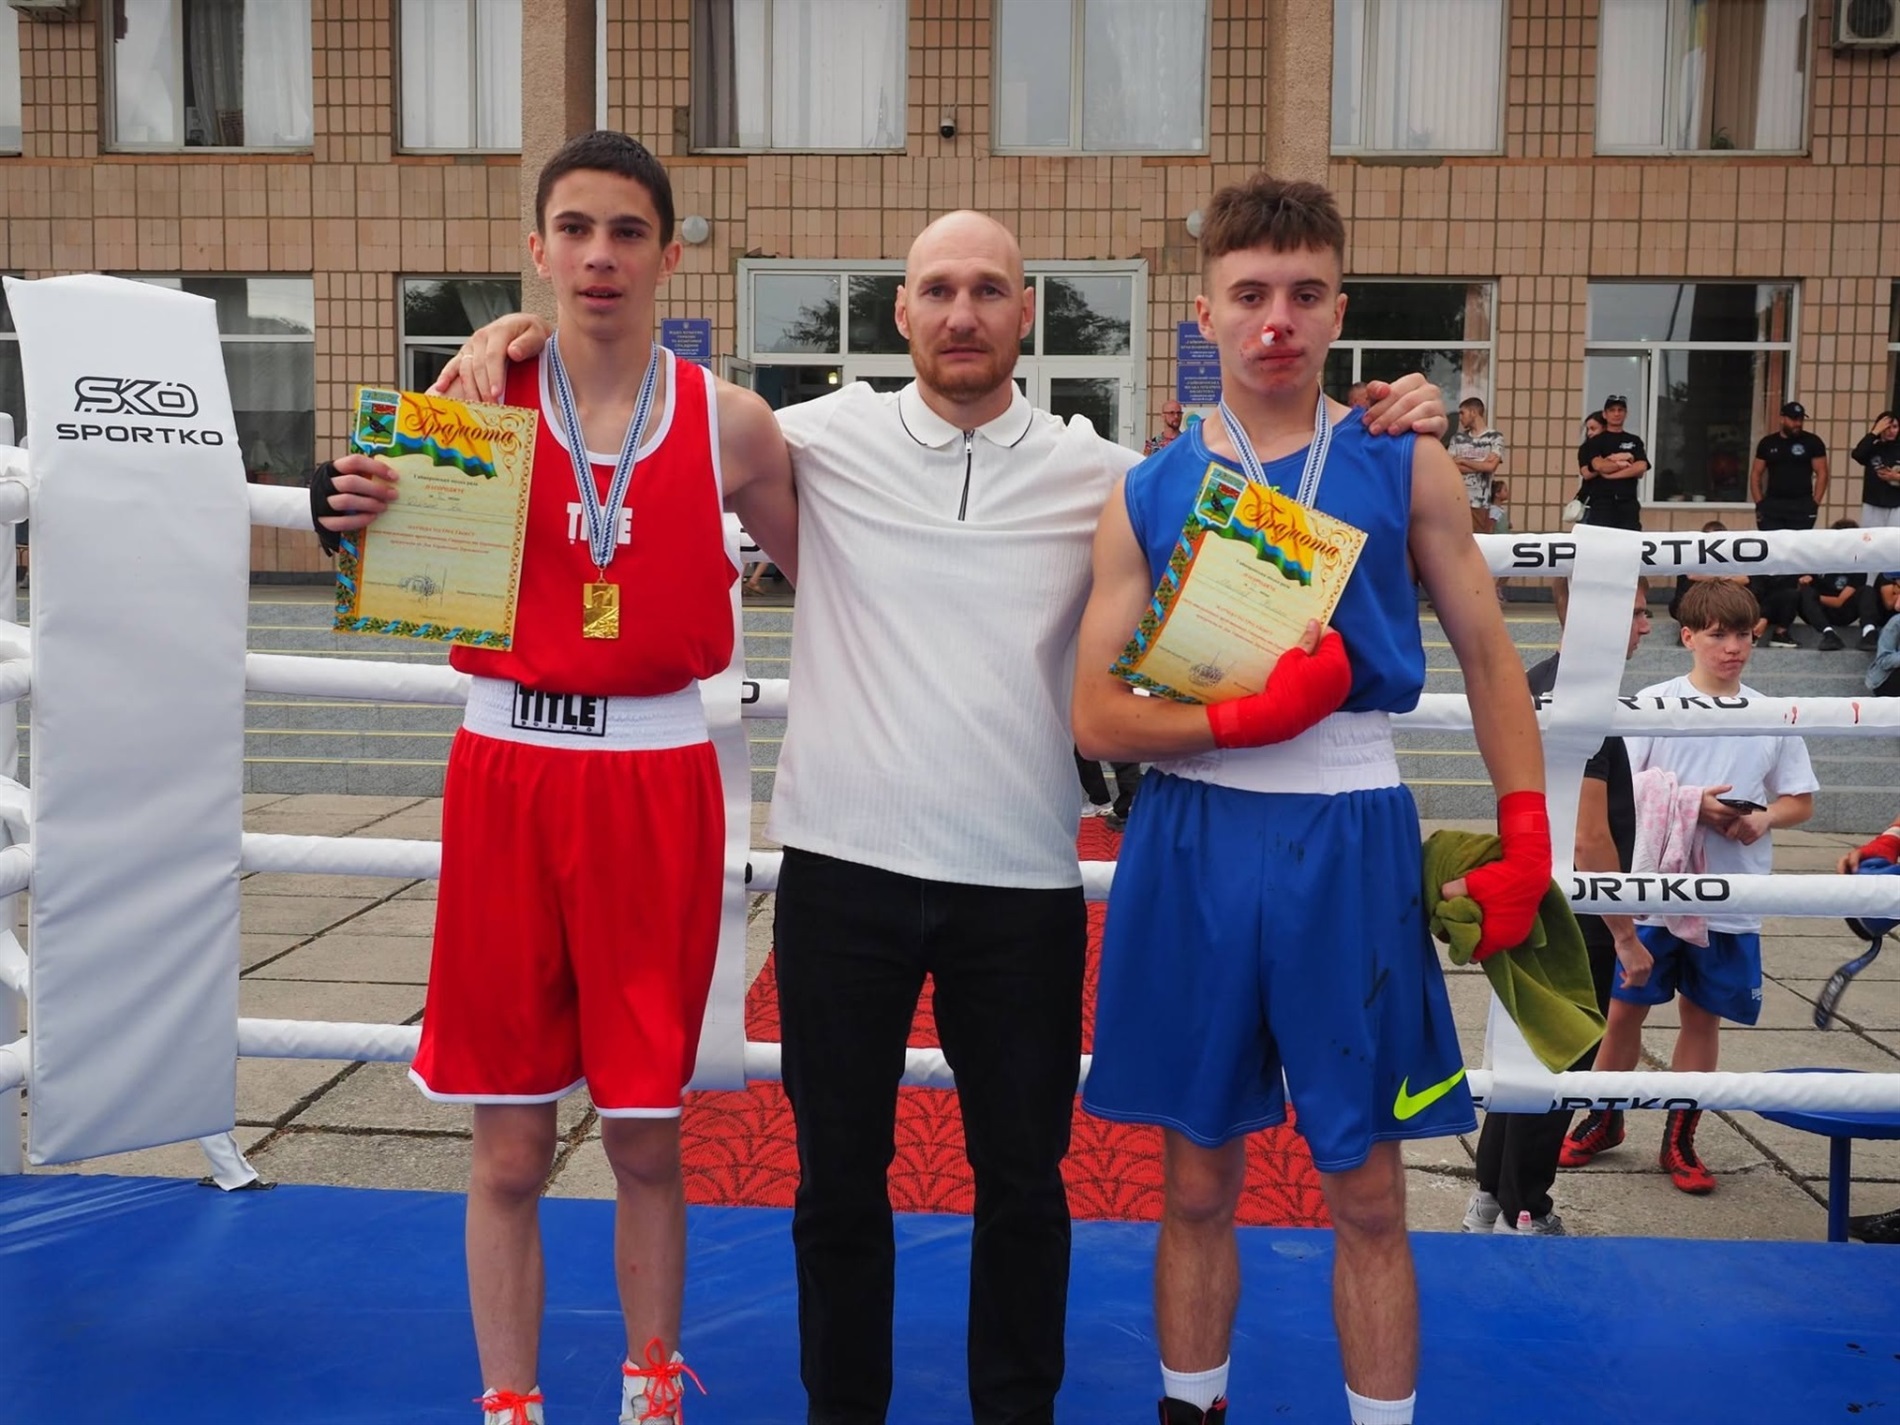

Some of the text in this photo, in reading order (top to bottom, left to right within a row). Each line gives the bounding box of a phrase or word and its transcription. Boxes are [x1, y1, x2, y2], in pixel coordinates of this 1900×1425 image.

[74, 376, 199, 418] SKO
[56, 423, 224, 446] SPORTKO
[404, 405, 516, 445] Грамота
[567, 502, 633, 545] TIE
[1242, 500, 1340, 556] Грамота
[1512, 538, 1769, 568] SPRTKO
[519, 684, 598, 727] TITLE
